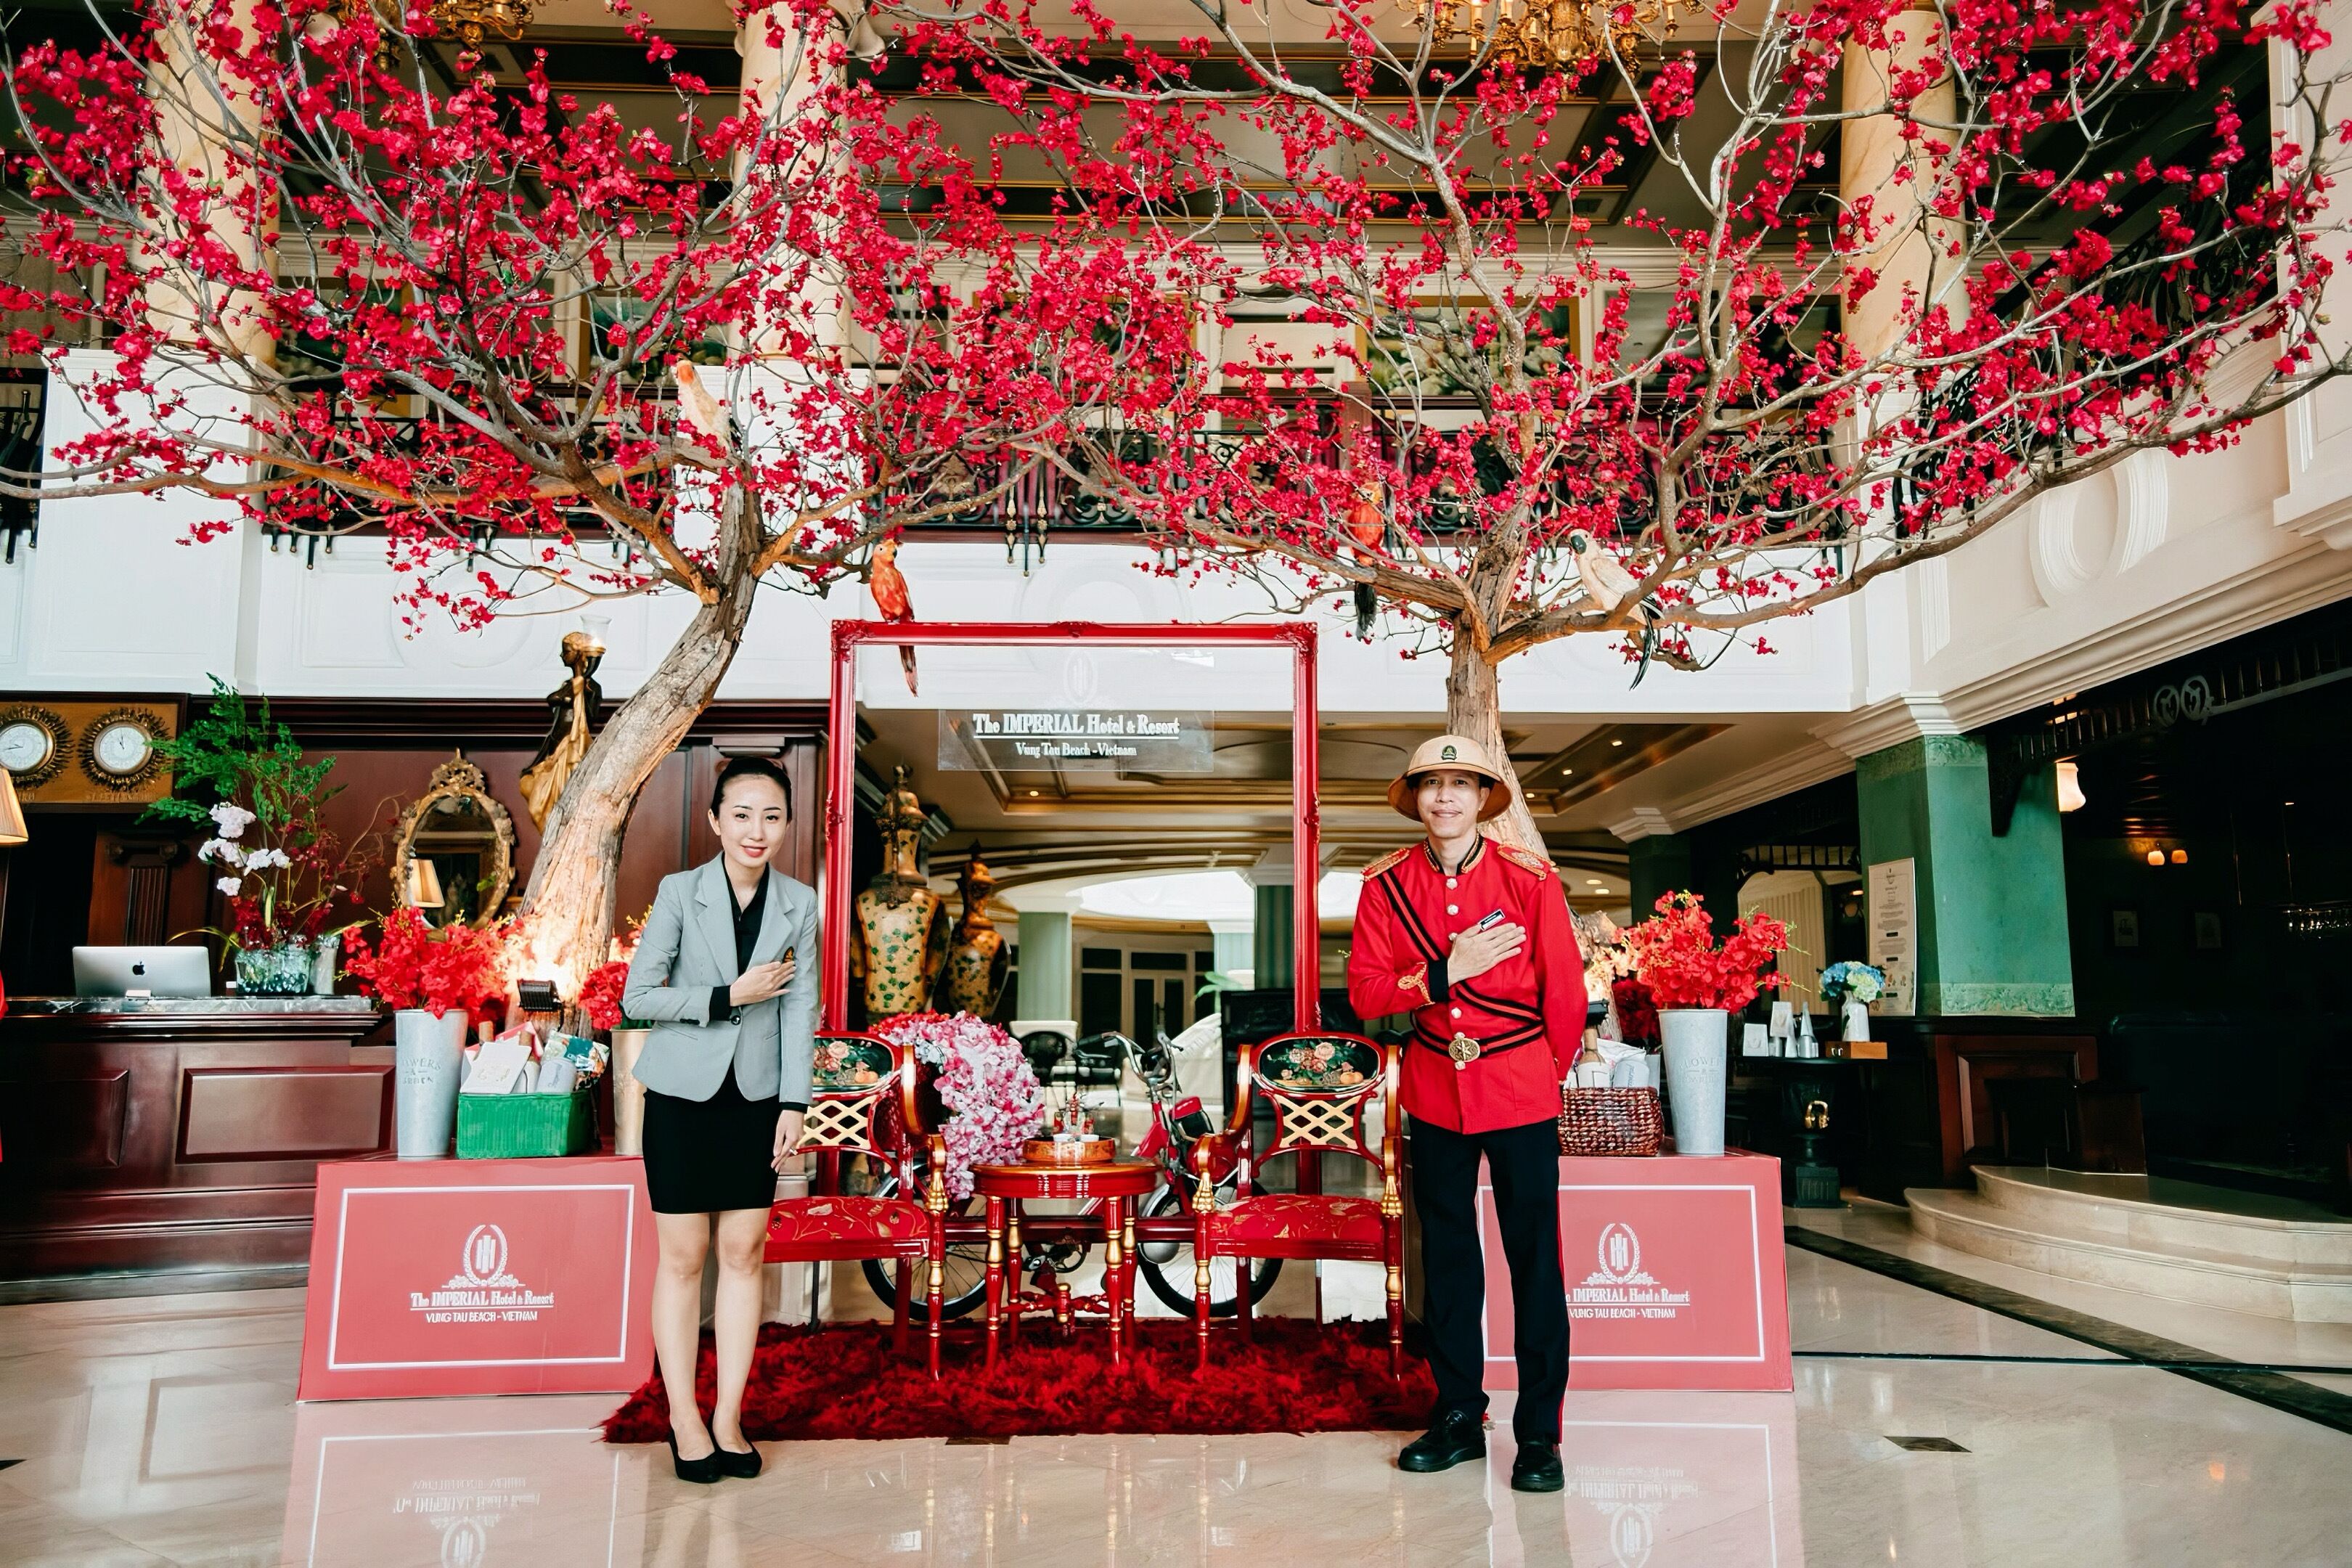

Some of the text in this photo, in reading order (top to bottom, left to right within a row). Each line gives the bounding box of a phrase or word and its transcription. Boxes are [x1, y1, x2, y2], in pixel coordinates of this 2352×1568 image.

[973, 714, 1180, 735] The IMPERIAL Hotel & Resort
[1016, 742, 1040, 759] Vung
[1041, 743, 1060, 756] Tau
[1062, 742, 1091, 756] Beach
[1097, 742, 1138, 756] Vietnam
[410, 1292, 430, 1307] The
[432, 1291, 489, 1307] IMPERIAL
[491, 1290, 517, 1305] Hotel
[525, 1290, 555, 1304] Resort
[1572, 1288, 1628, 1302] IMPERIAL
[1629, 1288, 1654, 1302] Hotel
[425, 1312, 452, 1323] VUNG
[452, 1312, 468, 1323] TAU
[469, 1312, 496, 1322] BEACH
[502, 1311, 538, 1321] VIETNAM
[1569, 1308, 1594, 1318] VUNG
[1595, 1308, 1609, 1318] TAU
[1610, 1308, 1636, 1318] BEACH
[1641, 1308, 1676, 1318] VIETNAM
